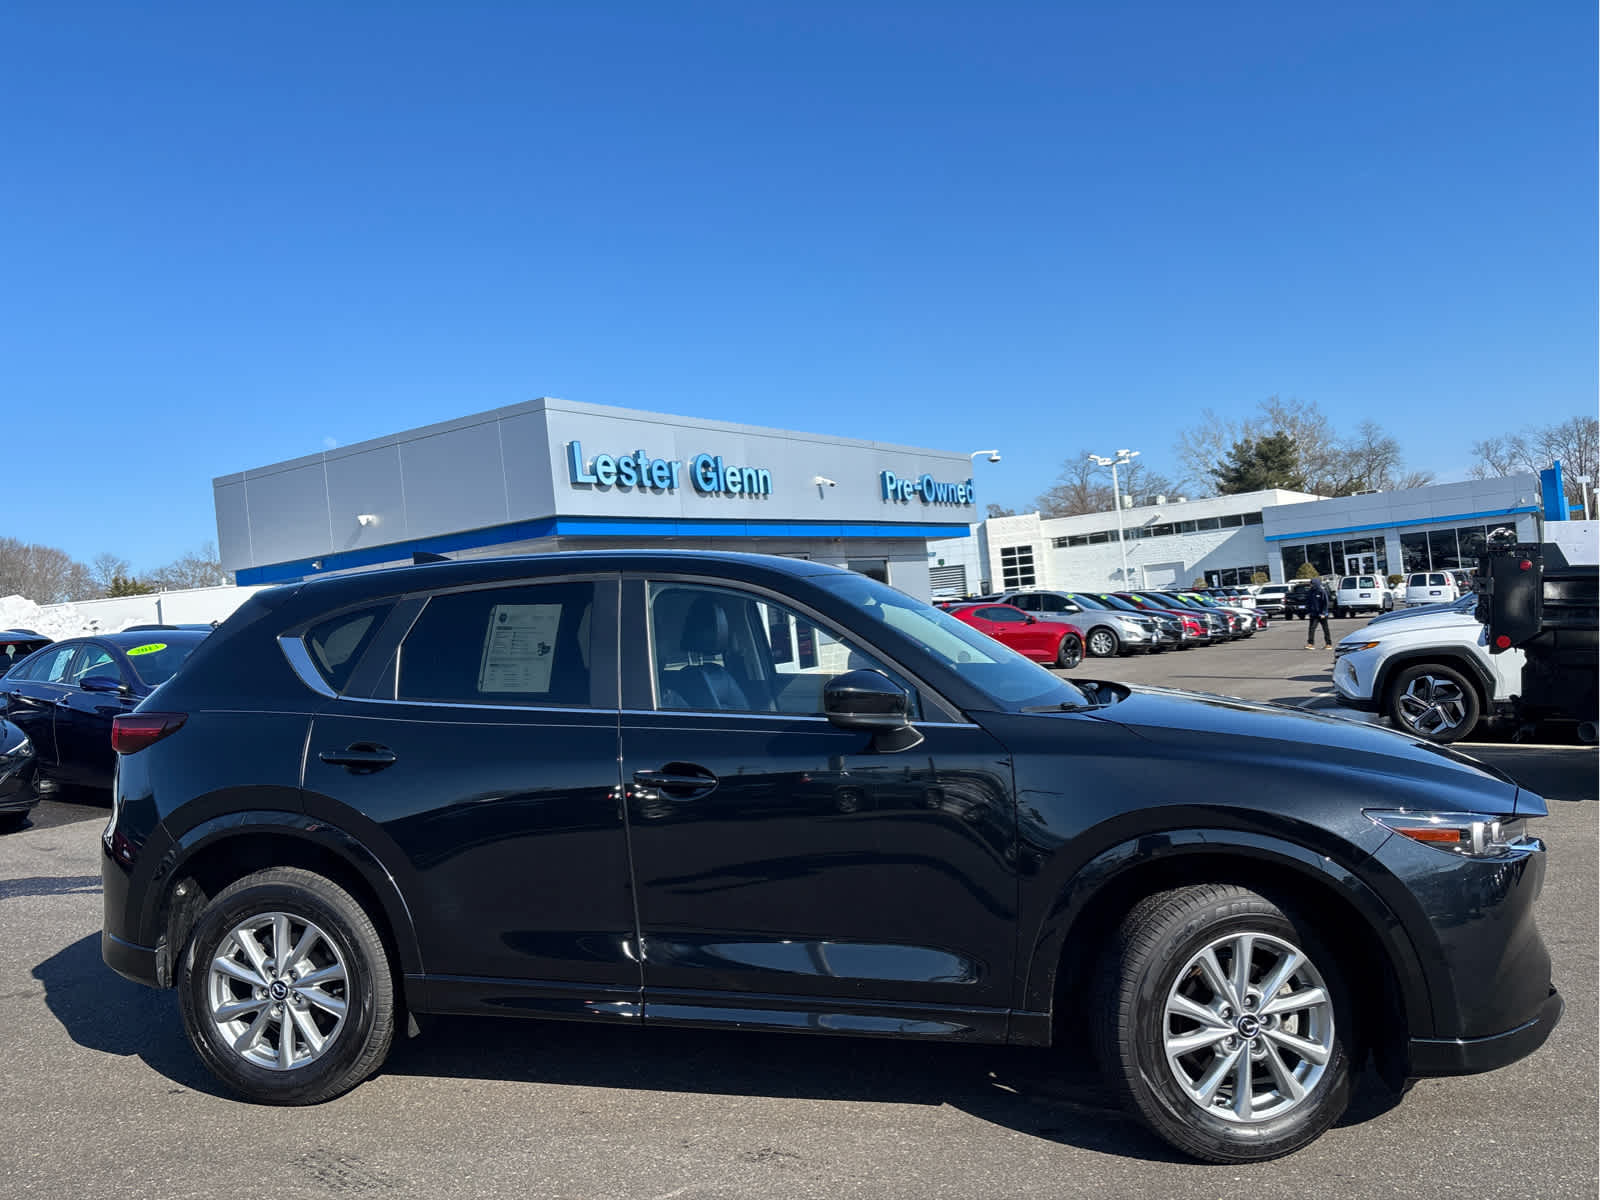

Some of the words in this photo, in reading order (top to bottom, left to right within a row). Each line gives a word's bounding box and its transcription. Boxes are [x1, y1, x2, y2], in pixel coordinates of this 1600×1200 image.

[567, 440, 681, 490] Lester
[689, 453, 773, 495] Glenn
[880, 470, 975, 504] Pre-Owned
